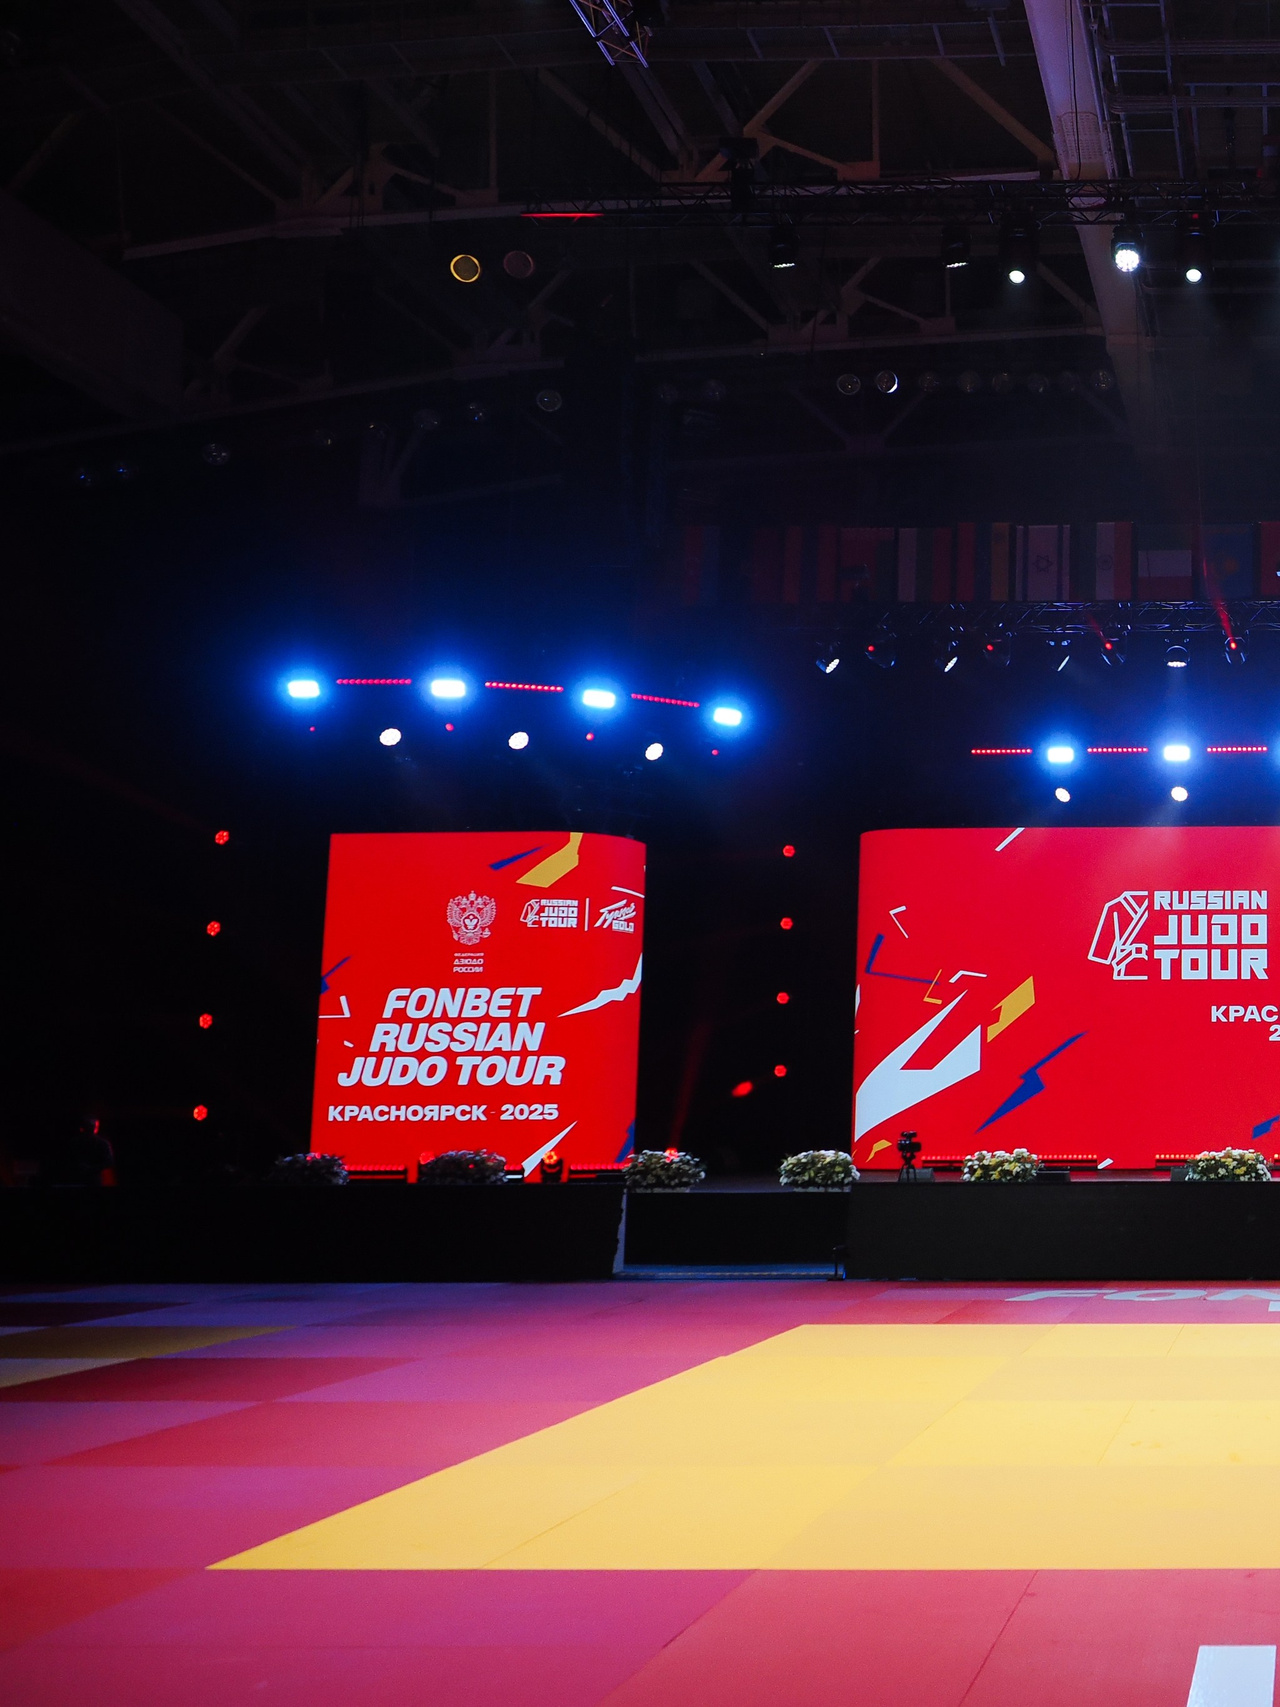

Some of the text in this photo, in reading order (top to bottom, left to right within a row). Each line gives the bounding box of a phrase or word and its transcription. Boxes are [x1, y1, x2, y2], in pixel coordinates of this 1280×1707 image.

[540, 906, 578, 917] JUDO
[1153, 890, 1268, 910] RUSSIAN
[540, 917, 578, 928] TOUR
[612, 920, 635, 932] GOLD
[1153, 914, 1268, 945] JUDO
[1153, 948, 1268, 980] TOUR
[381, 987, 542, 1019] FONBET
[369, 1022, 546, 1052] RUSSIAN
[337, 1055, 566, 1087] JUDO TOUR
[328, 1105, 487, 1121] КРАСНОЯРСК
[500, 1104, 559, 1121] 2025
